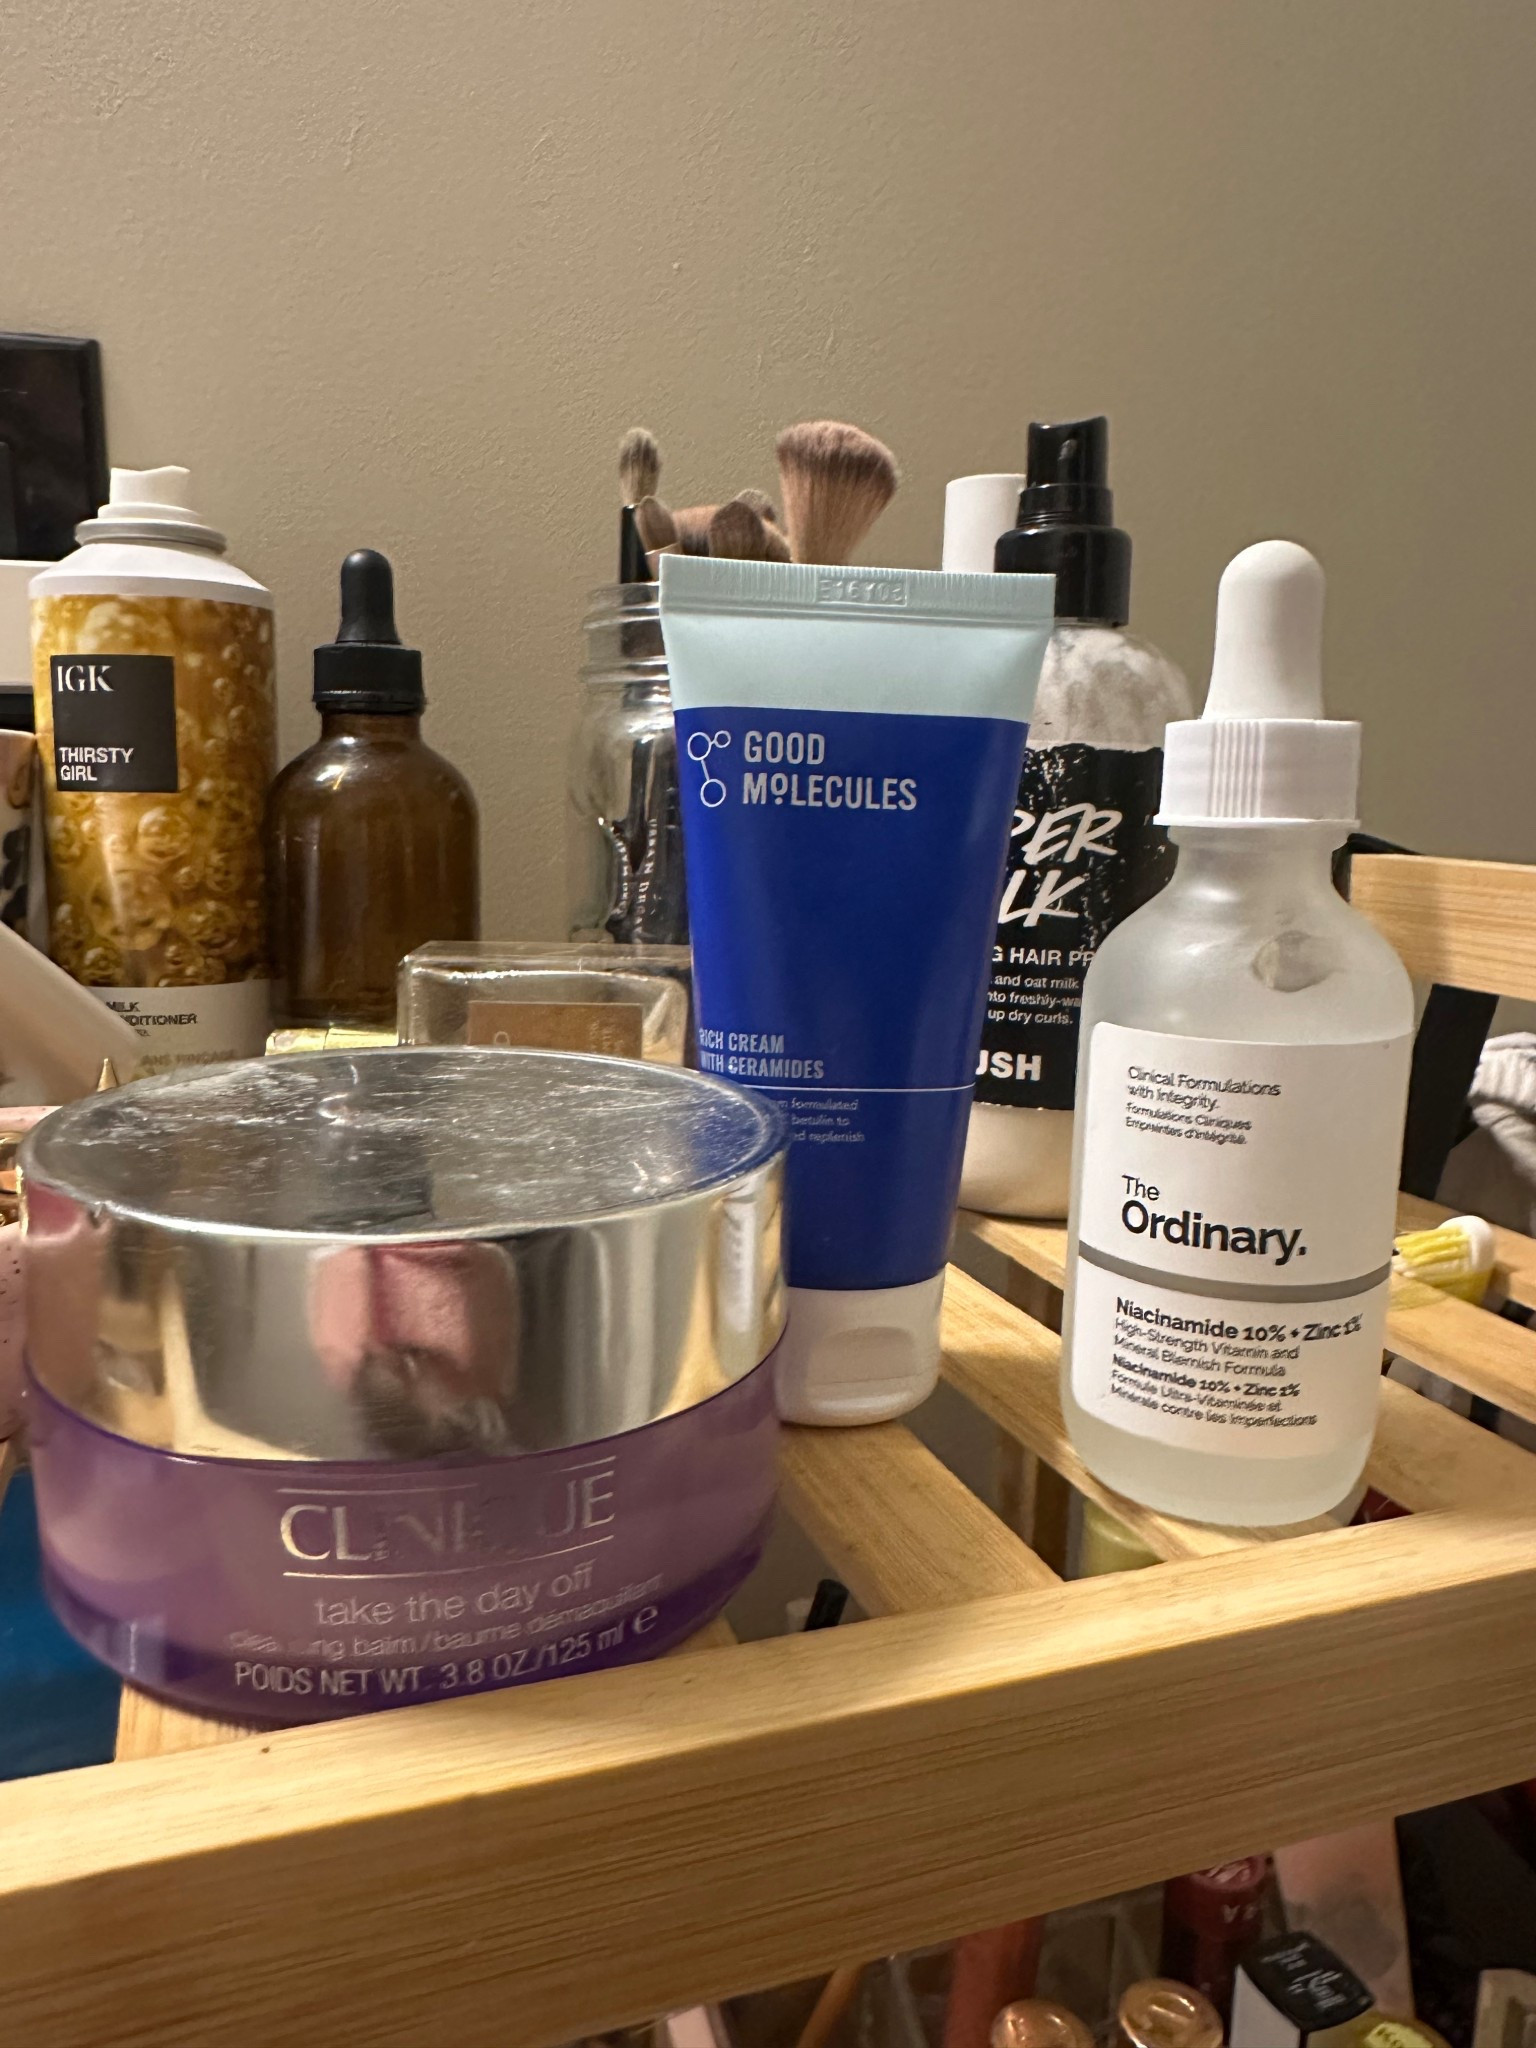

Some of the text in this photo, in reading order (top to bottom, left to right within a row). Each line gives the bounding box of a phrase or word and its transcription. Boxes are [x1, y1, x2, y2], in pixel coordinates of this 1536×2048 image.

[57, 665, 115, 692] IGK
[59, 746, 134, 764] THIRSTY
[744, 730, 826, 765] GOOD
[60, 765, 98, 782] GIRL
[742, 772, 918, 811] MOLECULES
[998, 869, 1086, 927] LK
[1009, 947, 1062, 966] HAIR
[994, 974, 1021, 987] and
[1023, 977, 1048, 988] oat
[987, 990, 1007, 1003] nto
[987, 1010, 1005, 1022] up
[1008, 1009, 1032, 1025] dry
[698, 1028, 785, 1054] RICH CREAM
[700, 1050, 825, 1079] WITH CERAMIDES
[975, 1050, 1042, 1082] USH
[1127, 1085, 1154, 1100] with
[1128, 1066, 1282, 1097] Clinical Formulations
[1121, 1174, 1160, 1201] The
[1121, 1200, 1308, 1266] Ordinary.
[1116, 1296, 1239, 1339] Niacinamide
[1242, 1324, 1287, 1343] 10%
[1302, 1322, 1341, 1342] Zinc
[1114, 1317, 1301, 1360] High-Strength Vitamin and
[1113, 1353, 1198, 1388] Niacinamide
[1199, 1380, 1231, 1394] 10%
[1243, 1383, 1278, 1396] Zinc
[1279, 1382, 1301, 1397] 1%
[1161, 1350, 1222, 1373] Blemish
[1224, 1361, 1287, 1377] Formula
[279, 1470, 616, 1563] CLNIUE
[315, 1558, 597, 1626] take the day off
[234, 1661, 314, 1695] POIDS
[320, 1669, 373, 1696] NET
